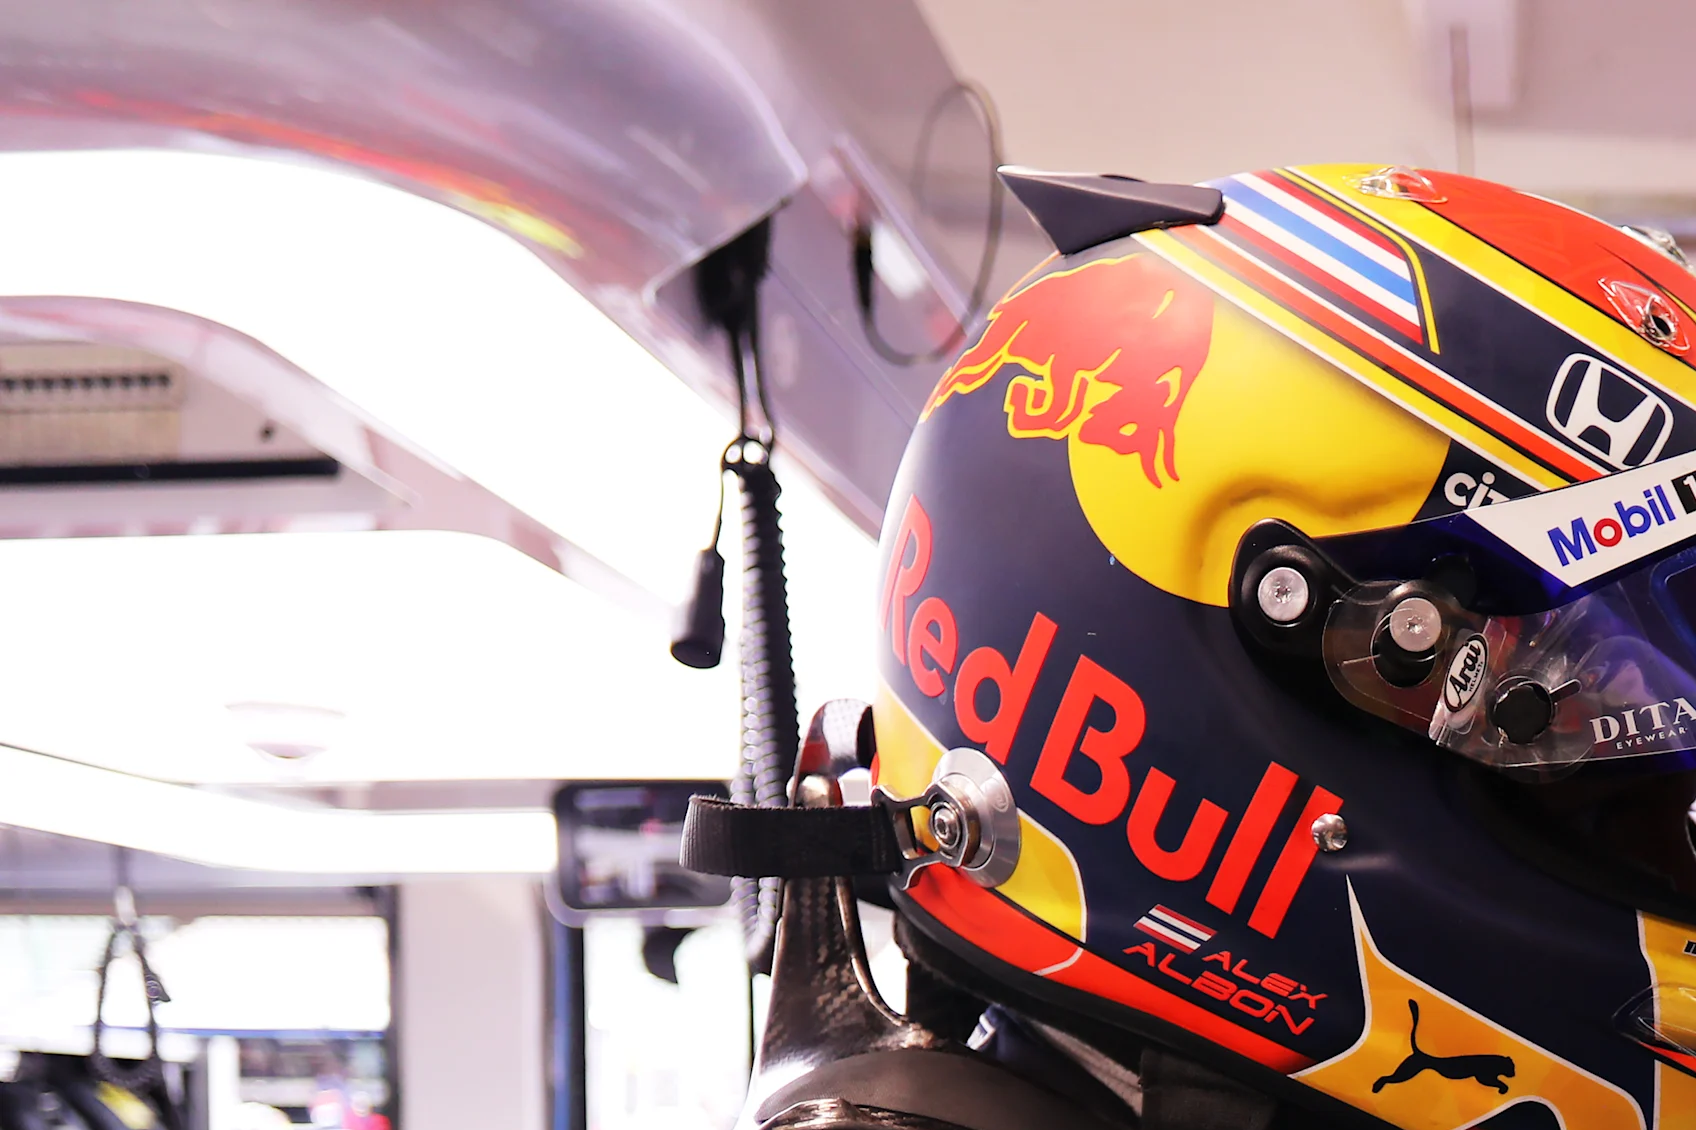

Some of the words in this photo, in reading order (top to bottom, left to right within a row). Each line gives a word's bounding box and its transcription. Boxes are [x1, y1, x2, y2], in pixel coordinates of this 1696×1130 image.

[1547, 484, 1676, 568] Mobil
[1448, 640, 1482, 709] Arai
[880, 493, 1059, 765] Red
[1029, 653, 1344, 939] Bull
[1616, 726, 1686, 750] EYEWEAR
[1122, 941, 1315, 1036] ALBON
[1201, 950, 1329, 1010] ALEX
